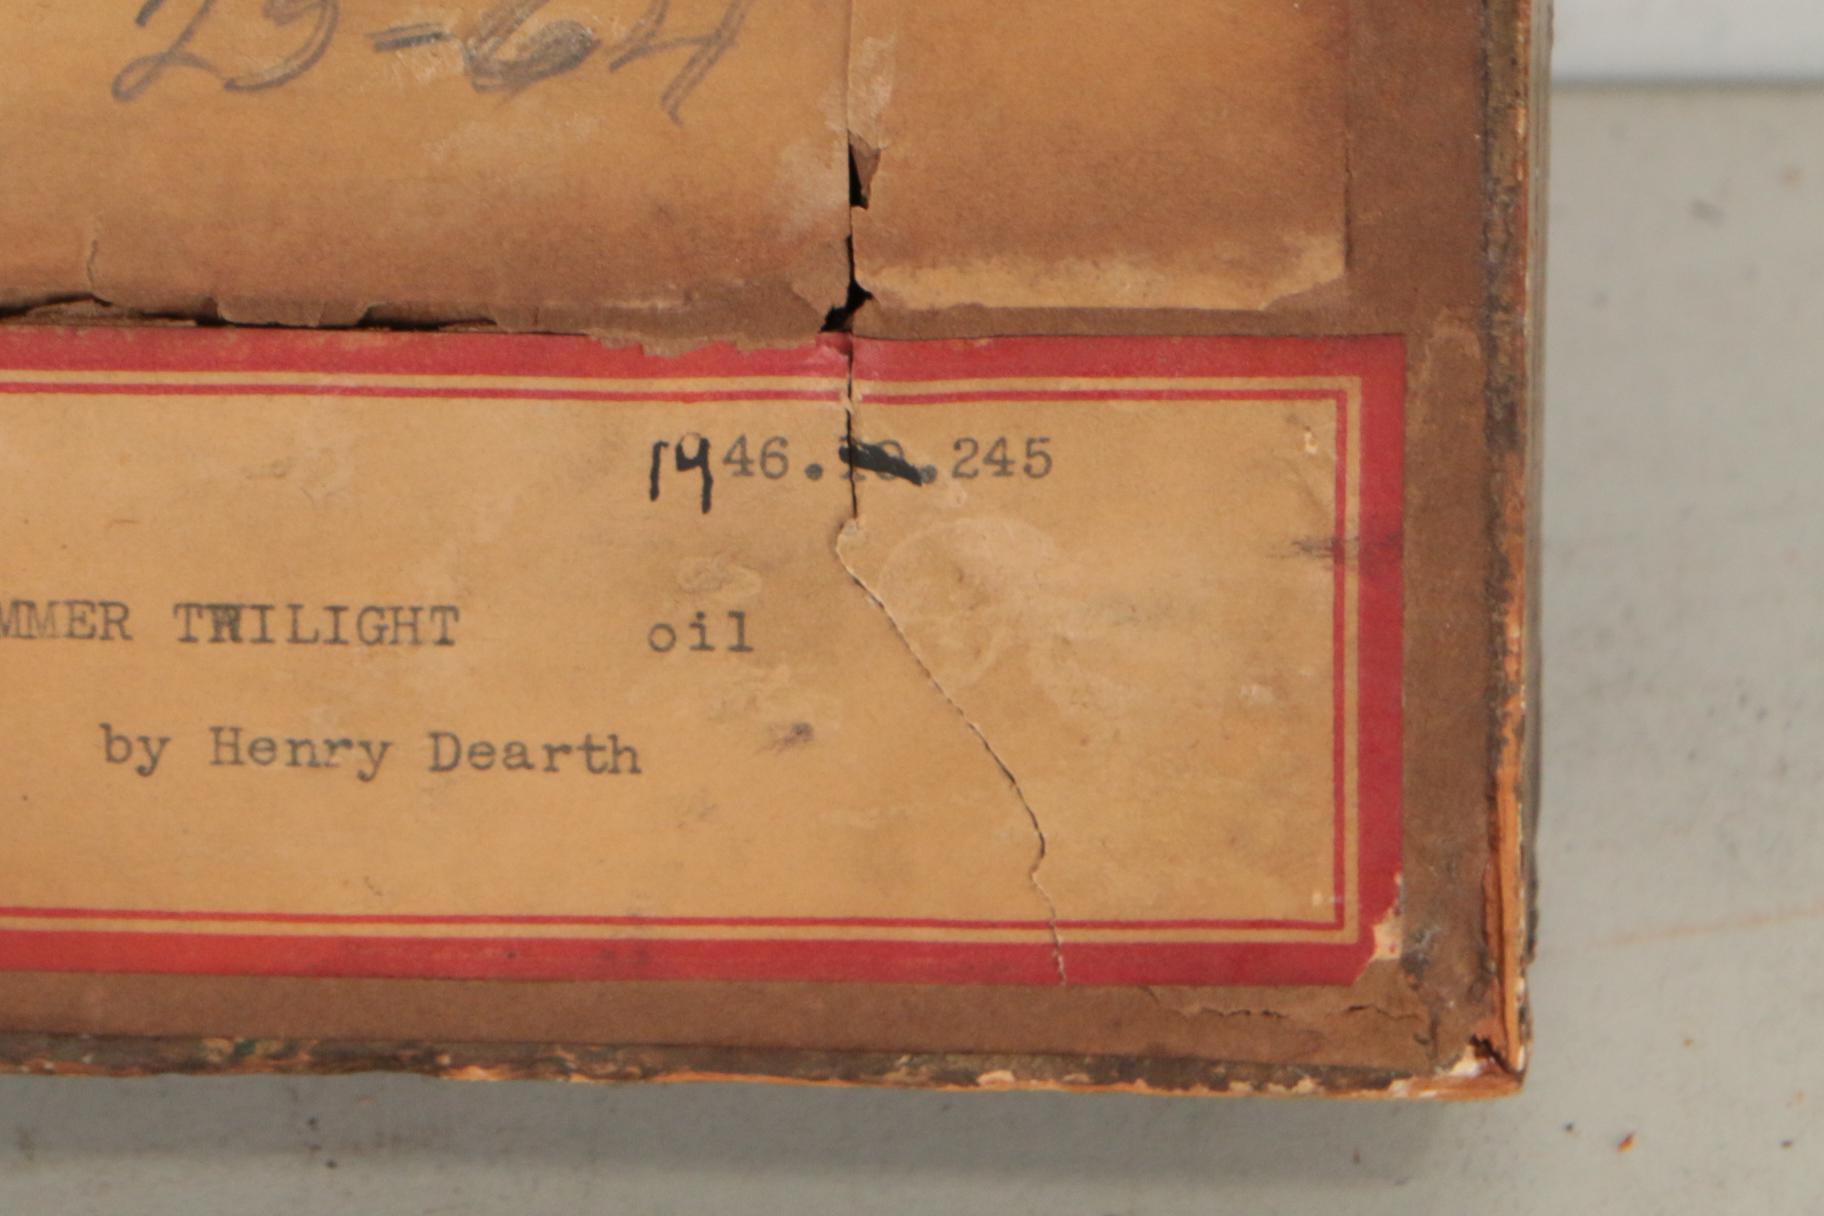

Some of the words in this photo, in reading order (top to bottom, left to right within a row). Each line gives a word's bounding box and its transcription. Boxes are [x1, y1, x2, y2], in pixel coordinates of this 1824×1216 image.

[174, 602, 460, 647] TWILIGHT
[649, 610, 754, 653] oil
[100, 723, 170, 776] by
[210, 727, 393, 782] Henry
[428, 730, 641, 775] Dearth
